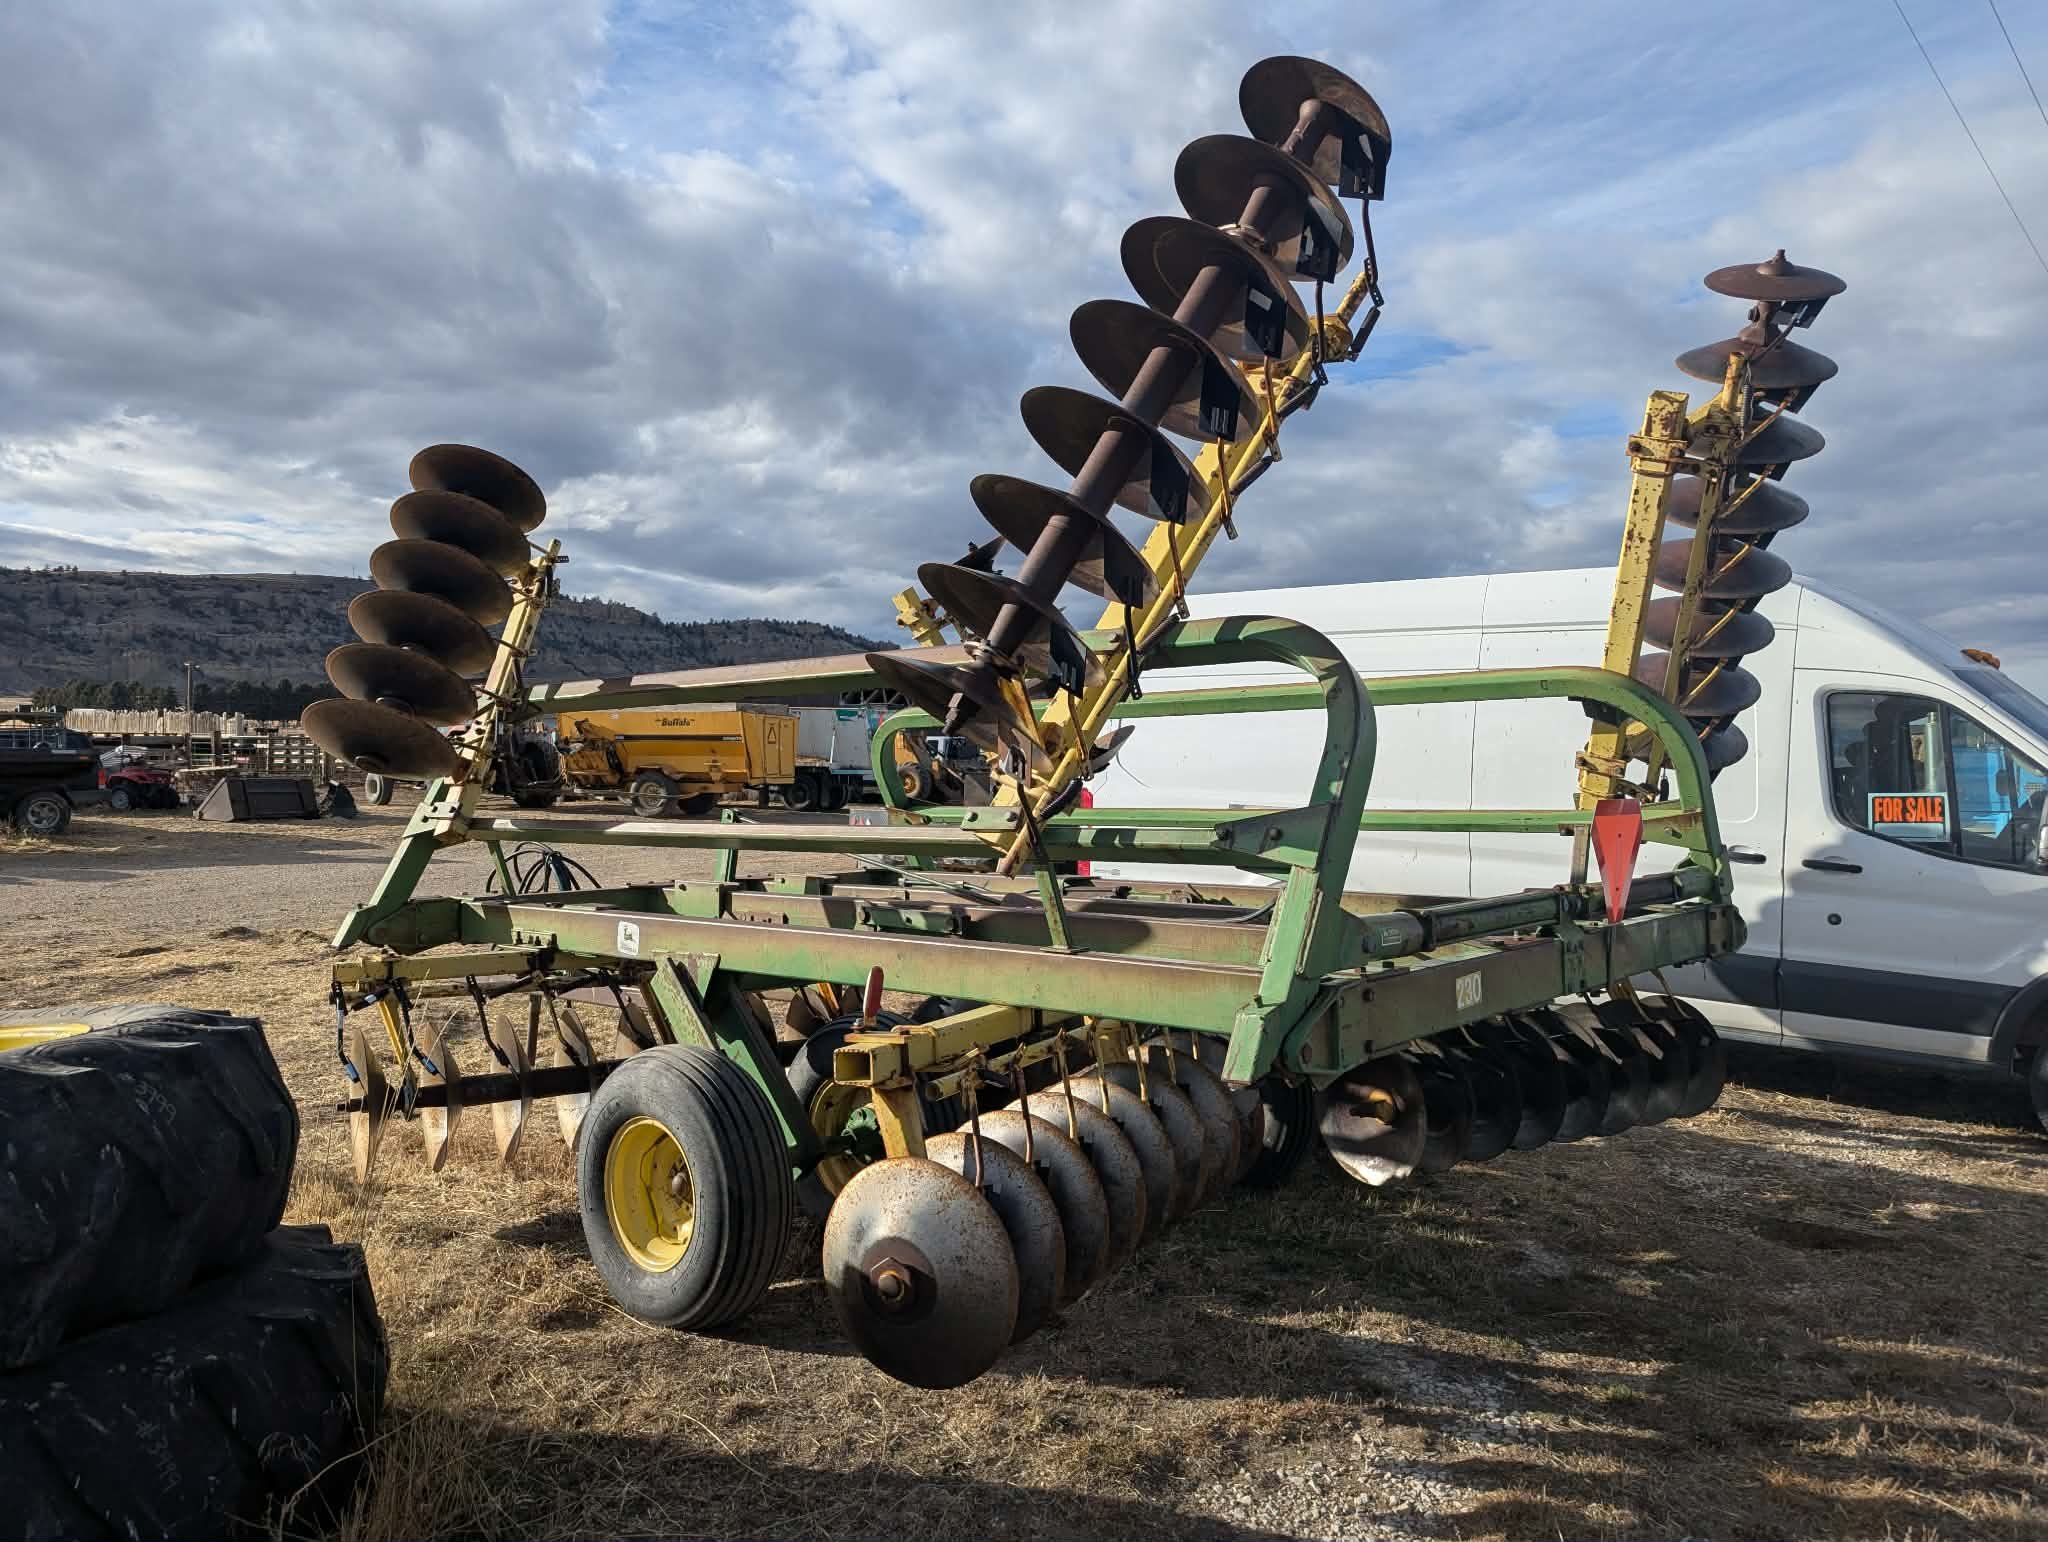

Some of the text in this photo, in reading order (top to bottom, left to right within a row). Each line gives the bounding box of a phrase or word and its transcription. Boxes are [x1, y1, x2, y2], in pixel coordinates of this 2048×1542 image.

[1874, 797, 1944, 822] FOR SALE
[1456, 973, 1481, 1008] 230
